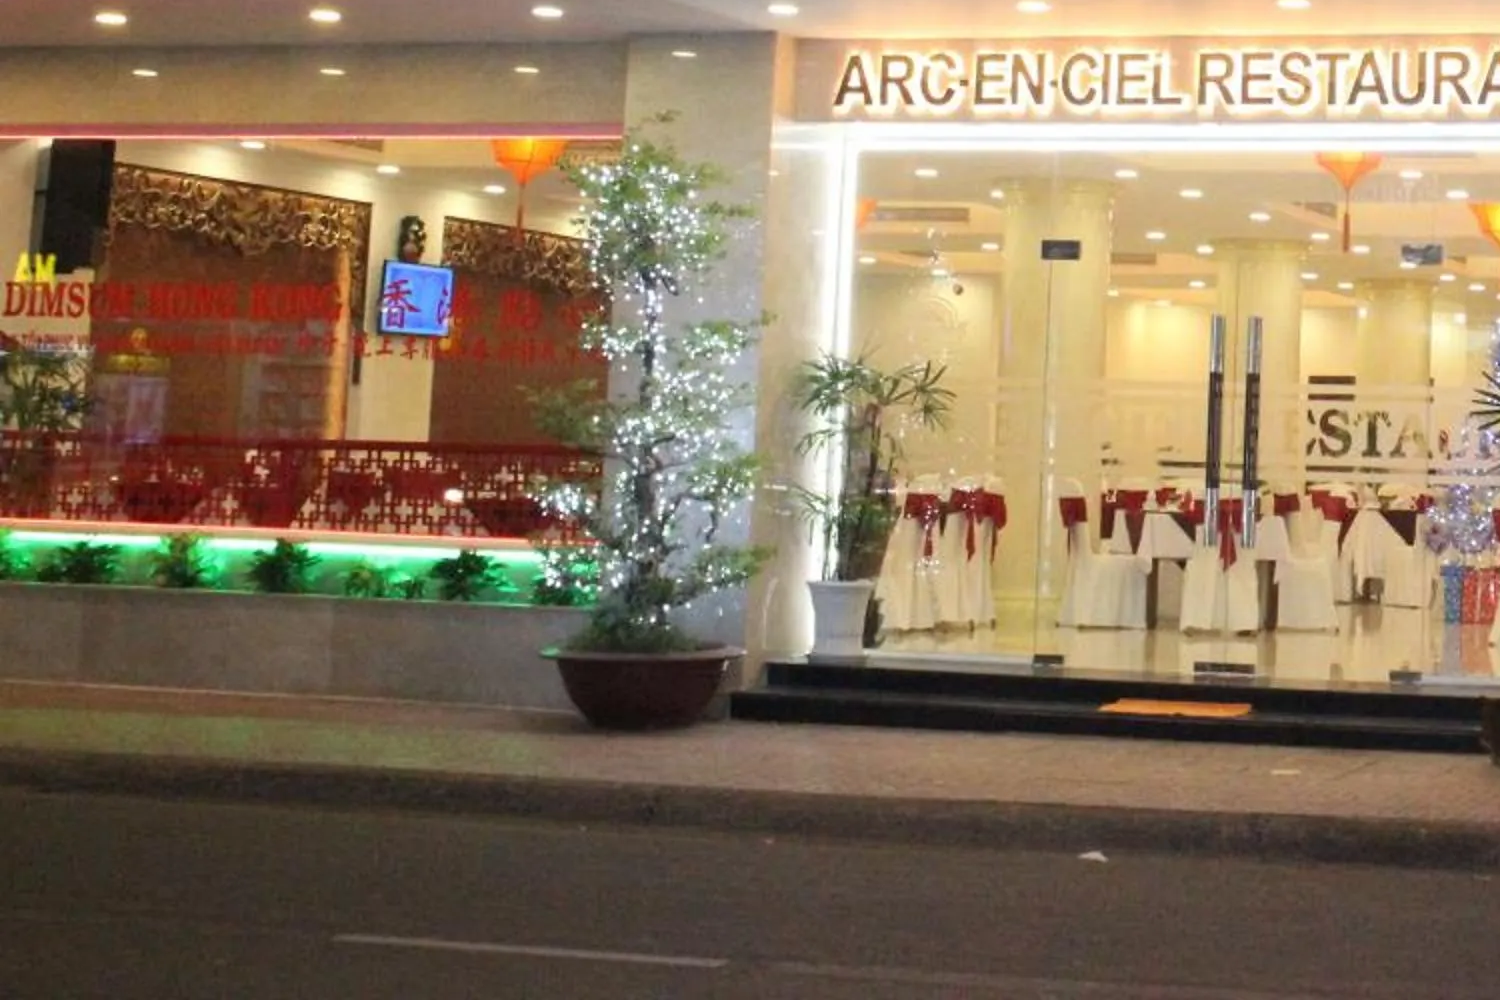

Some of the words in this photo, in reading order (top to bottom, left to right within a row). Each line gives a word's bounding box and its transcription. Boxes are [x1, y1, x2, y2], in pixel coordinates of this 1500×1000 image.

[2, 281, 135, 319] DIMSUM
[148, 281, 238, 320] HONG
[252, 281, 343, 323] KONG
